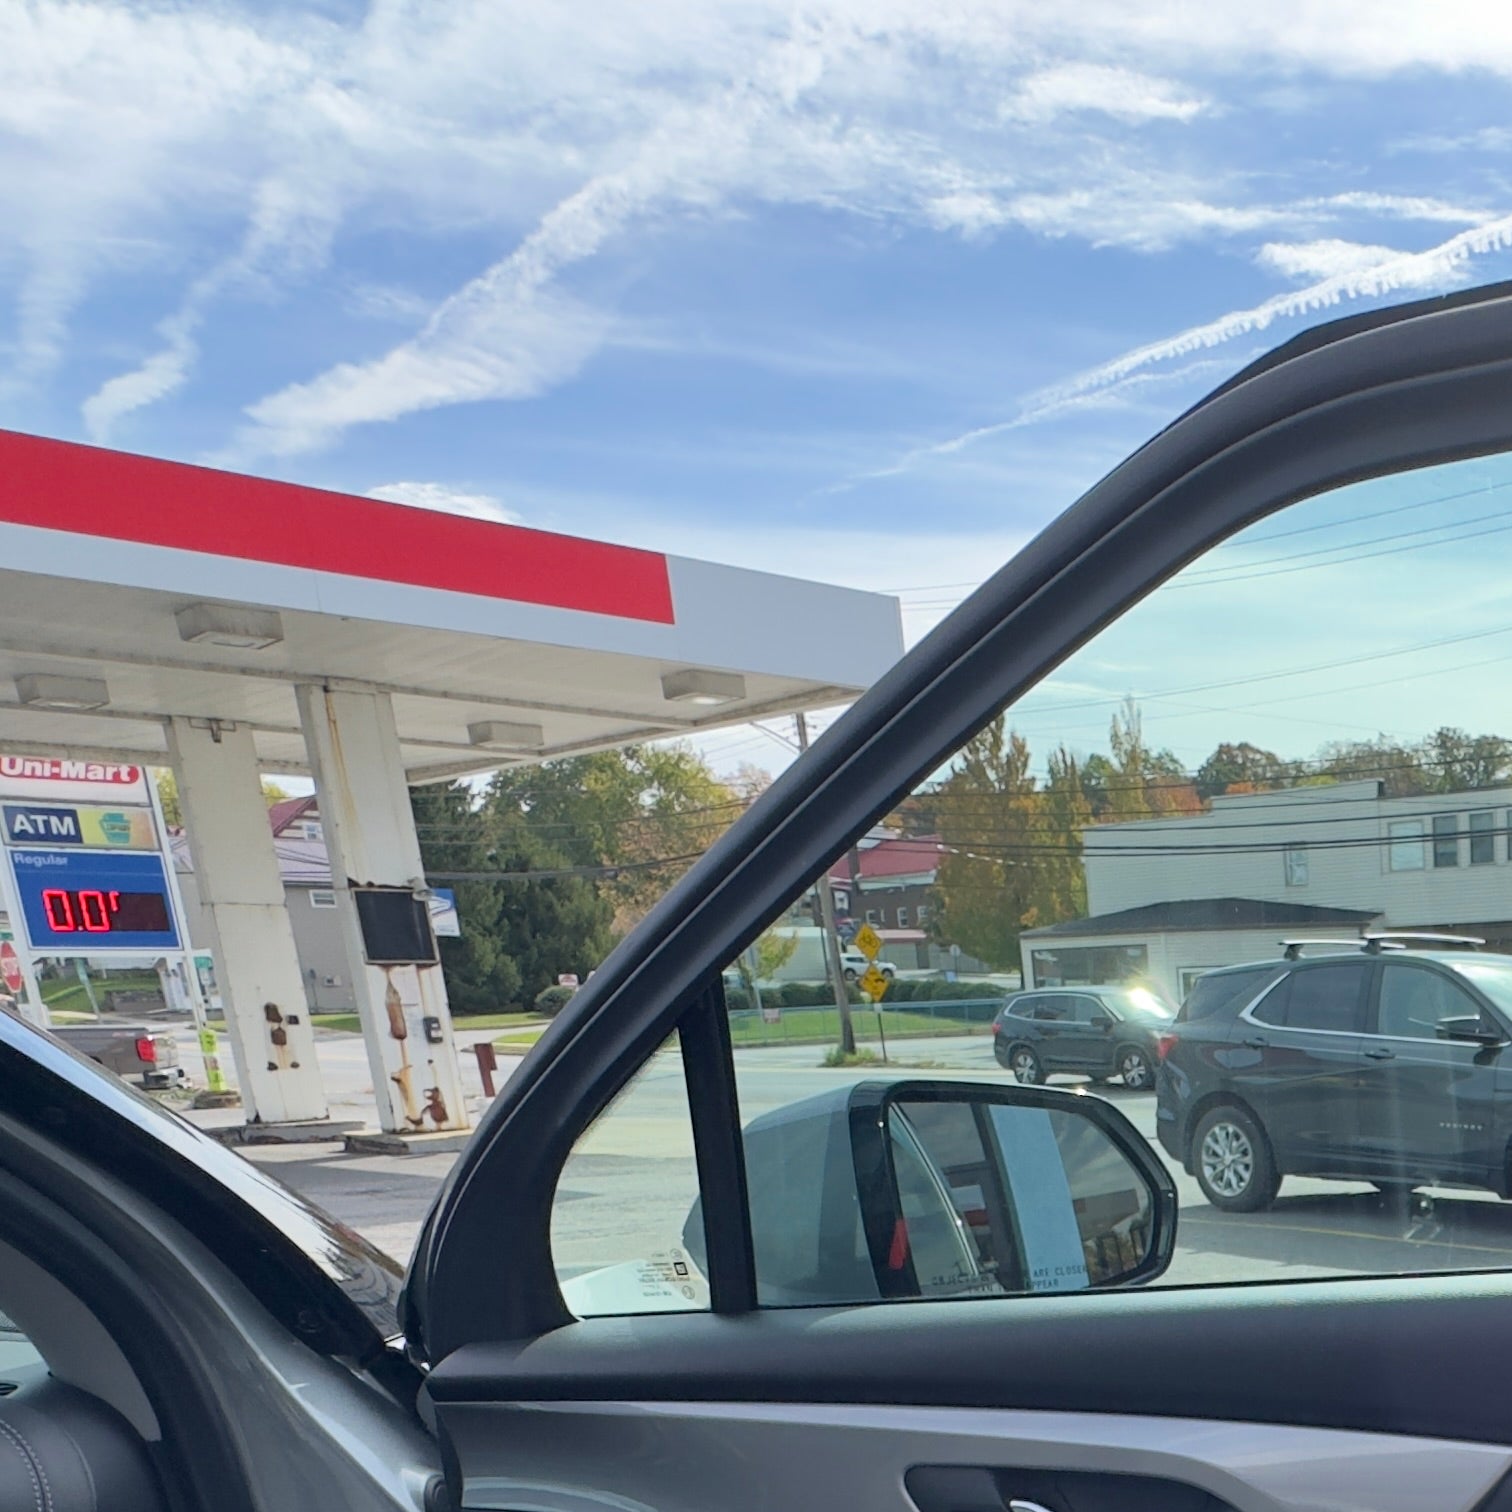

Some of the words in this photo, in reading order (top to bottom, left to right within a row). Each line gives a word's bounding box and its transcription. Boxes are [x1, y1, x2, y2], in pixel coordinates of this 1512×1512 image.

[1, 757, 131, 782] Uni-Mart
[13, 813, 76, 836] ATM
[13, 853, 68, 867] Regular
[1033, 1268, 1049, 1277] ARE
